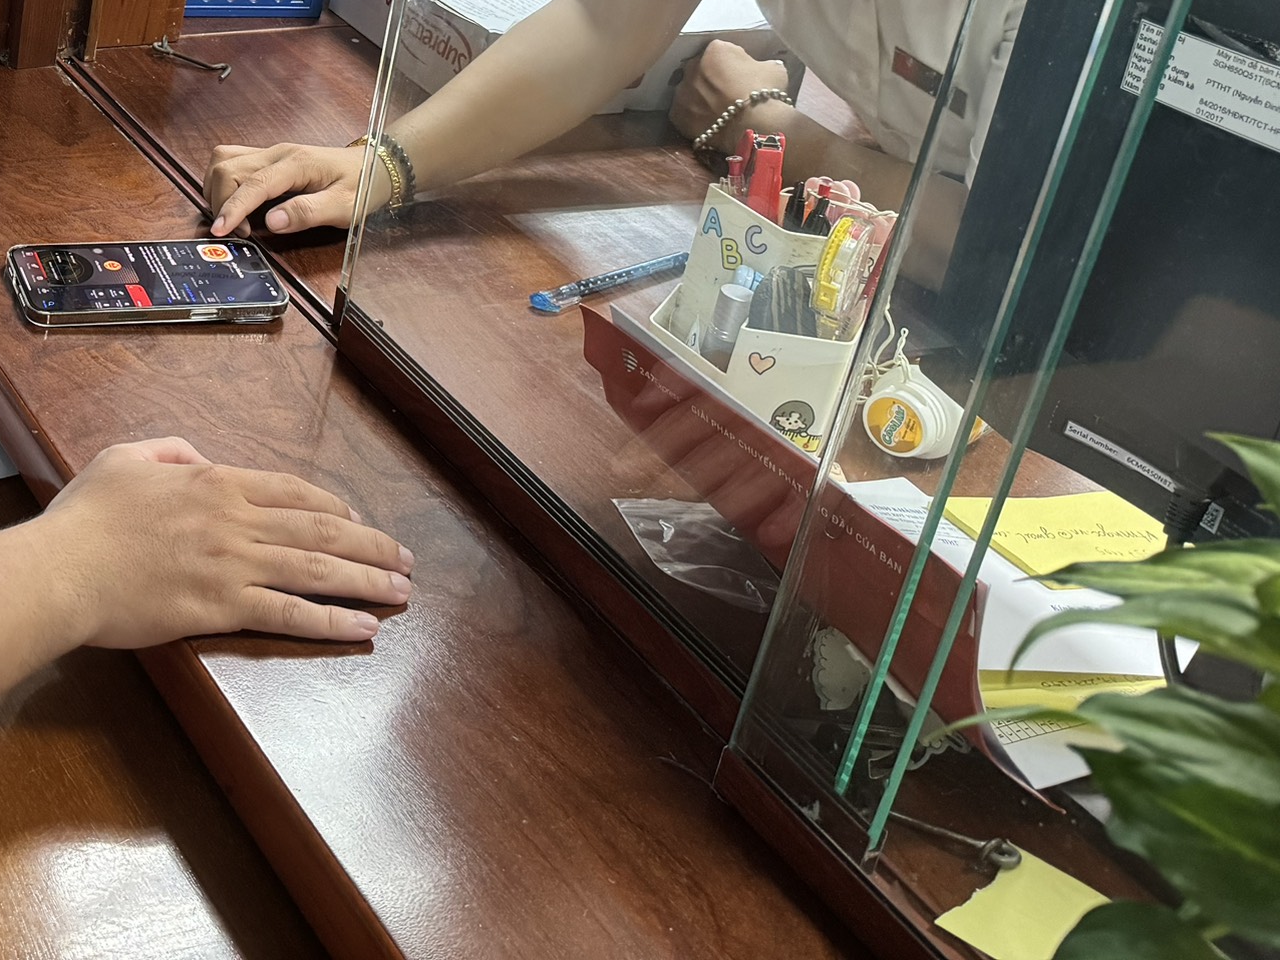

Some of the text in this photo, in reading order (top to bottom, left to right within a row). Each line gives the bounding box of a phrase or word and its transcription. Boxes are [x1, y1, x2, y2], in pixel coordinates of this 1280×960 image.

[1205, 78, 1231, 94] PTTHT
[1195, 108, 1224, 123] 01/2017
[702, 206, 768, 270] A B C
[1068, 425, 1089, 440] Serial
[691, 404, 709, 422] GIẢI
[738, 439, 776, 472] CHUYỂN
[855, 531, 878, 557] CỦA
